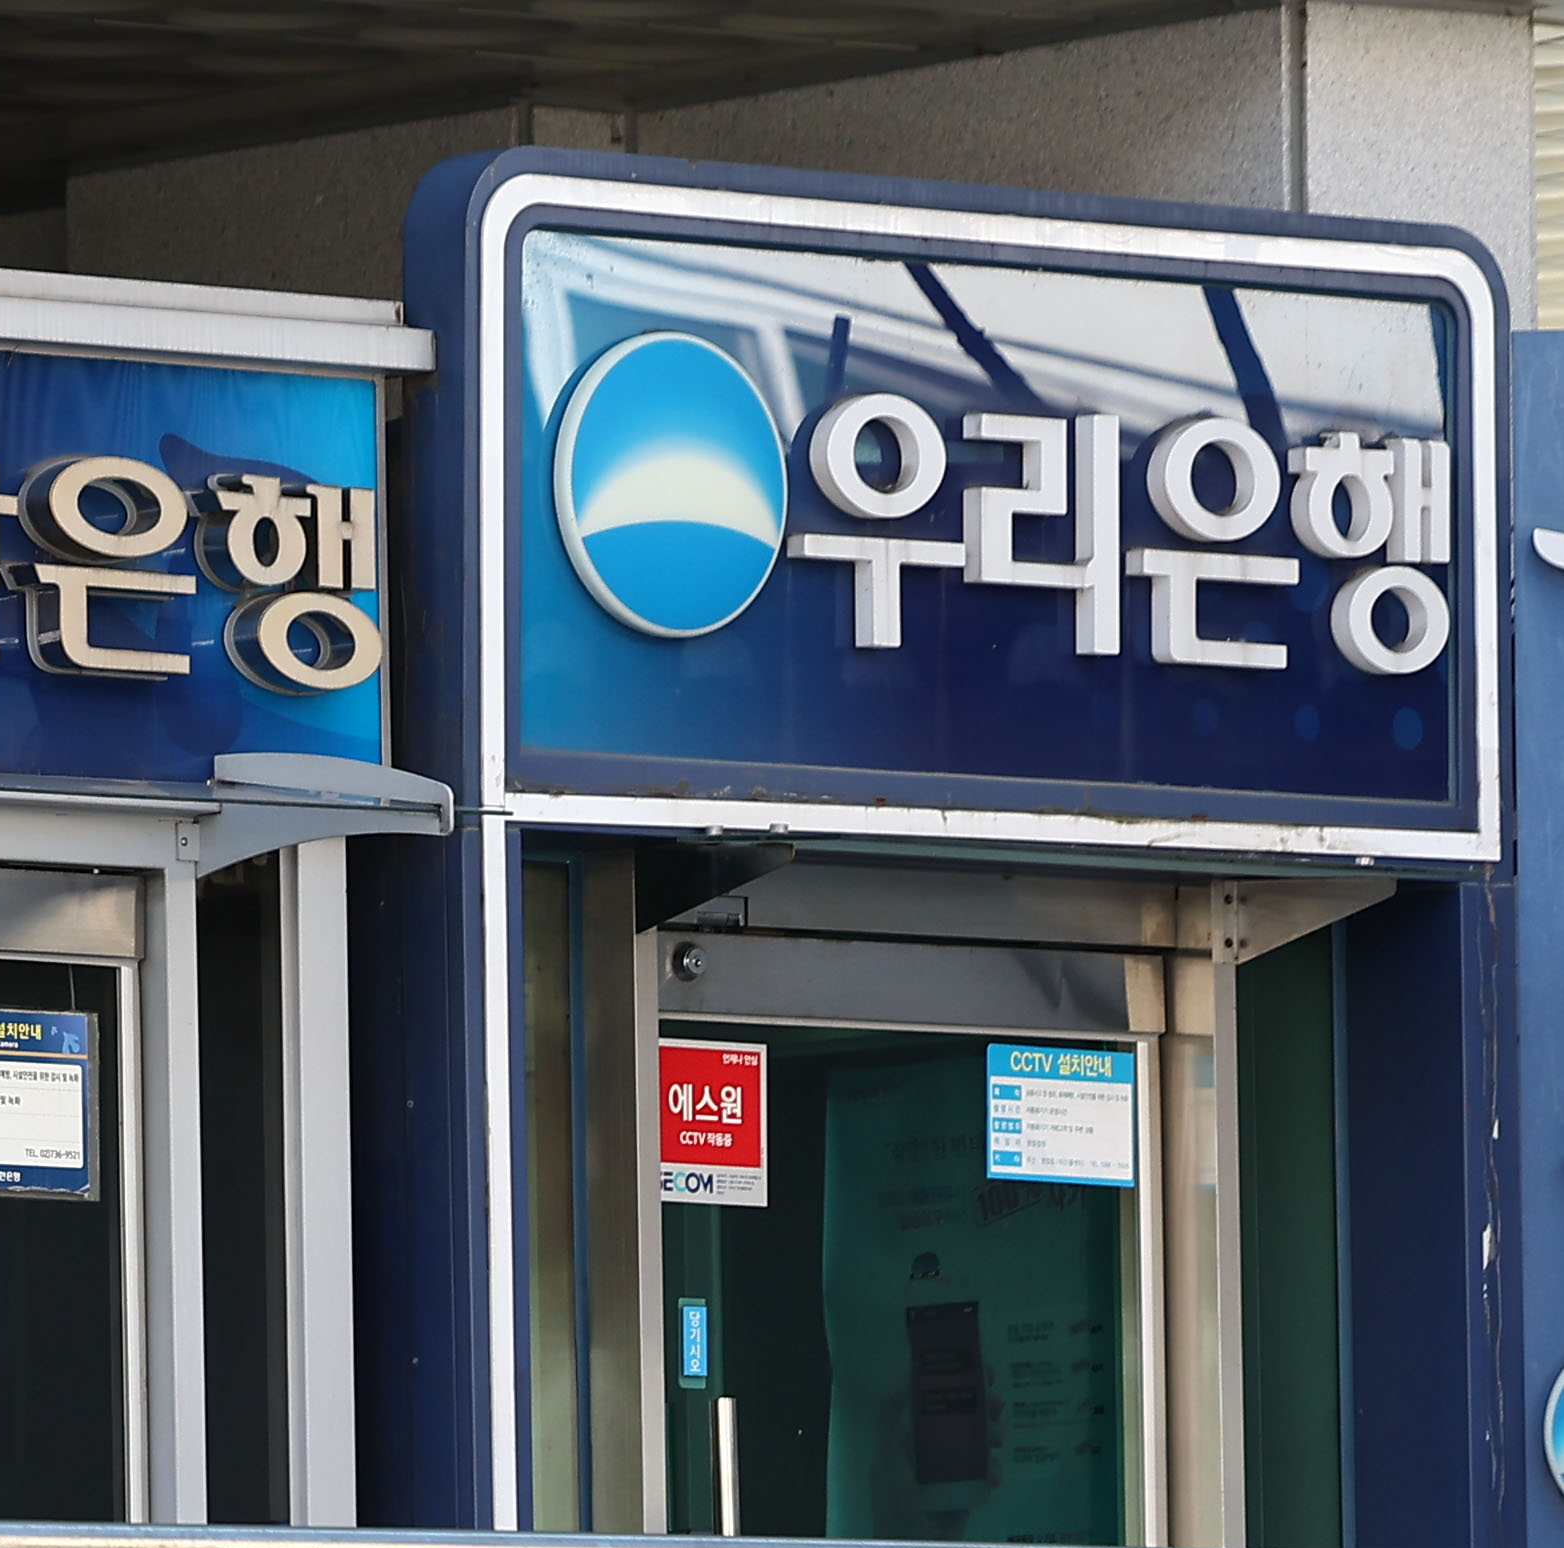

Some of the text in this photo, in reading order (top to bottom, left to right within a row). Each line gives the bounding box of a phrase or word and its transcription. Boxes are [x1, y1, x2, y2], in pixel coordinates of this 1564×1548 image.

[787, 392, 1451, 676] 우리은행
[1010, 1051, 1113, 1077] CCTV 설치안내
[668, 1083, 743, 1125] 에스원
[679, 1131, 733, 1147] CCTV 작동중
[661, 1171, 714, 1194] ECOM
